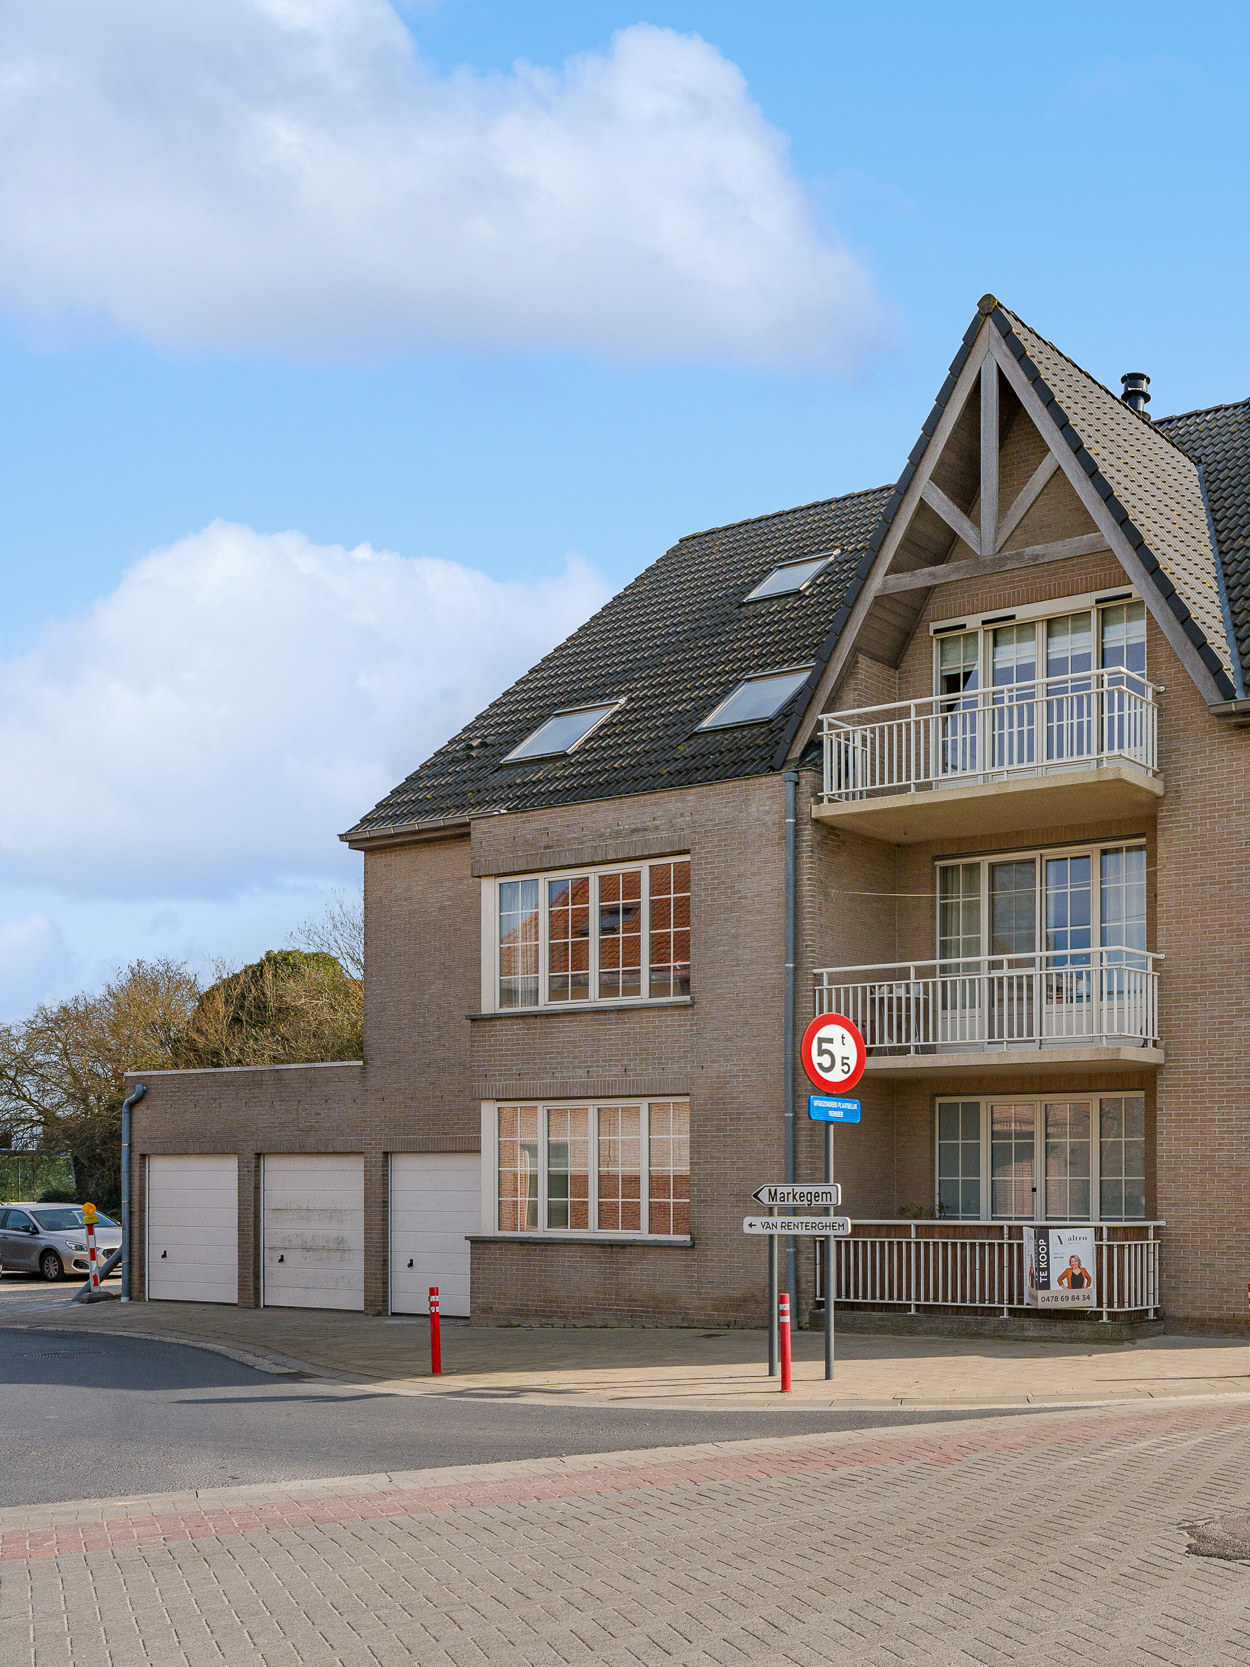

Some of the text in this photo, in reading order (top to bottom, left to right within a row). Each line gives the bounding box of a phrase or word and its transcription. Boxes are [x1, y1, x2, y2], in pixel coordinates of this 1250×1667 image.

[841, 1034, 846, 1046] t
[817, 1037, 851, 1074] 5 5
[768, 1188, 832, 1206] Markegem
[760, 1221, 845, 1231] VAN RENTERGHEM
[1039, 1239, 1047, 1283] TE KOOP
[1040, 1295, 1059, 1303] 0478
